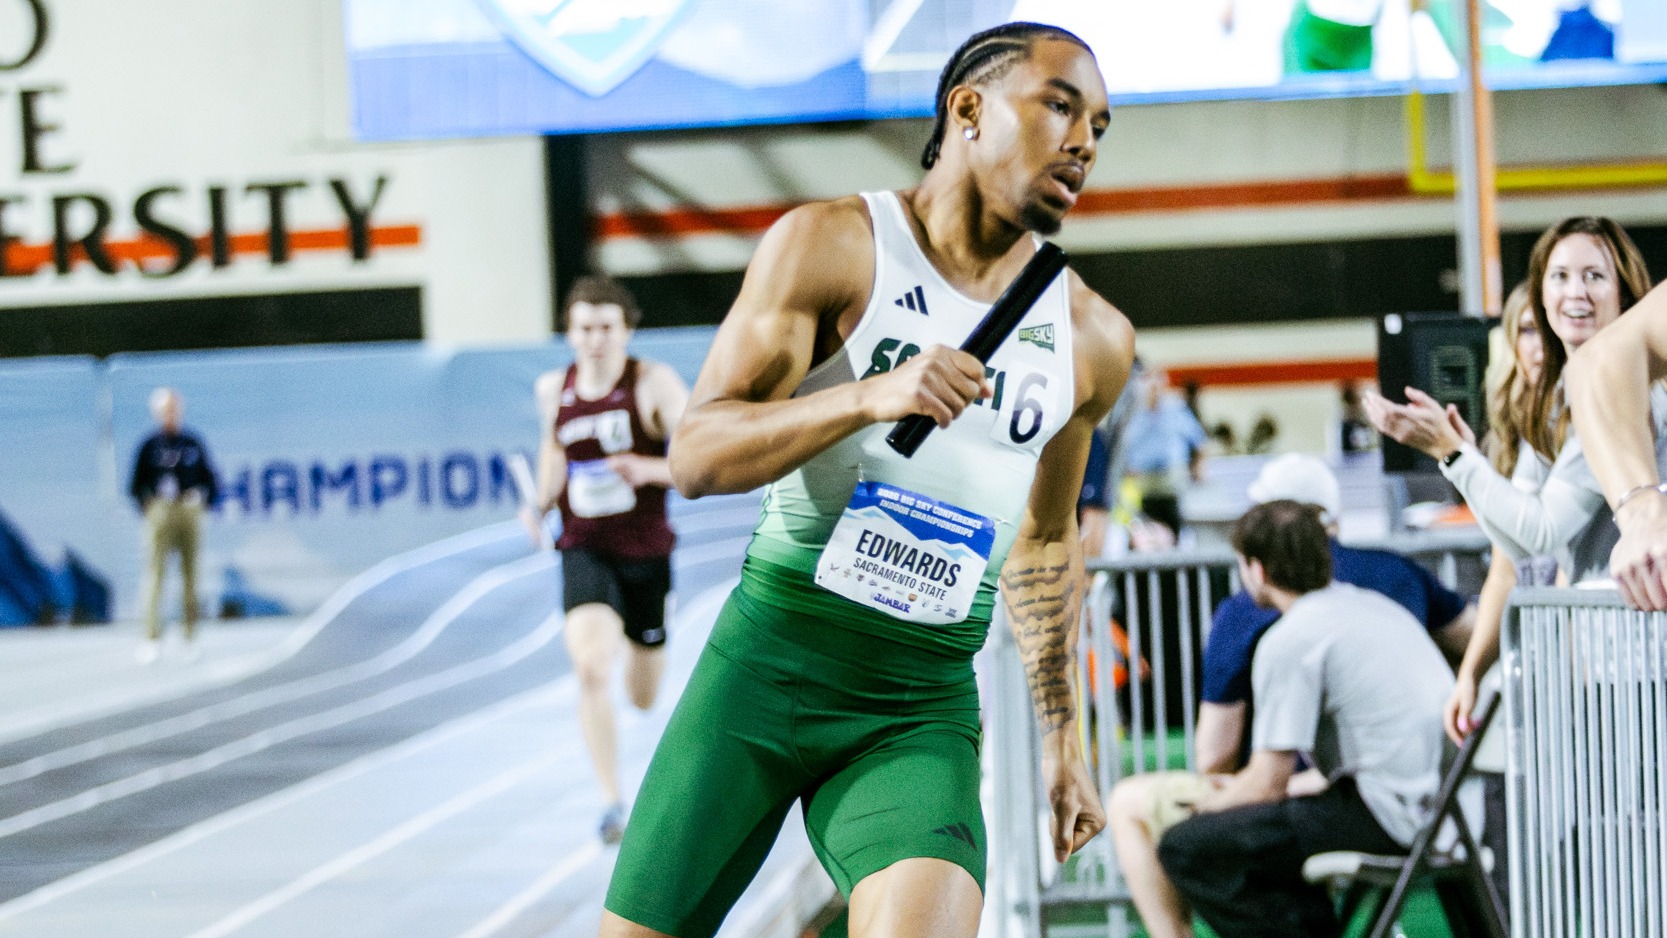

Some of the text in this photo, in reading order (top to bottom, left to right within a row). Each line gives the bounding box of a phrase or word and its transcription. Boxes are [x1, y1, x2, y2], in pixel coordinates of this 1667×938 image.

[0, 86, 78, 174] E
[1009, 372, 1048, 444] 6
[879, 499, 974, 538] INDOOR CHAMPIONSHIPS
[900, 494, 915, 507] BIG
[915, 500, 933, 512] SKY
[932, 505, 983, 529] CONFERENCE
[853, 557, 948, 601] SACRAMENTO STATE
[855, 529, 961, 587] EDWARDS
[874, 593, 911, 613] JAMBAR
